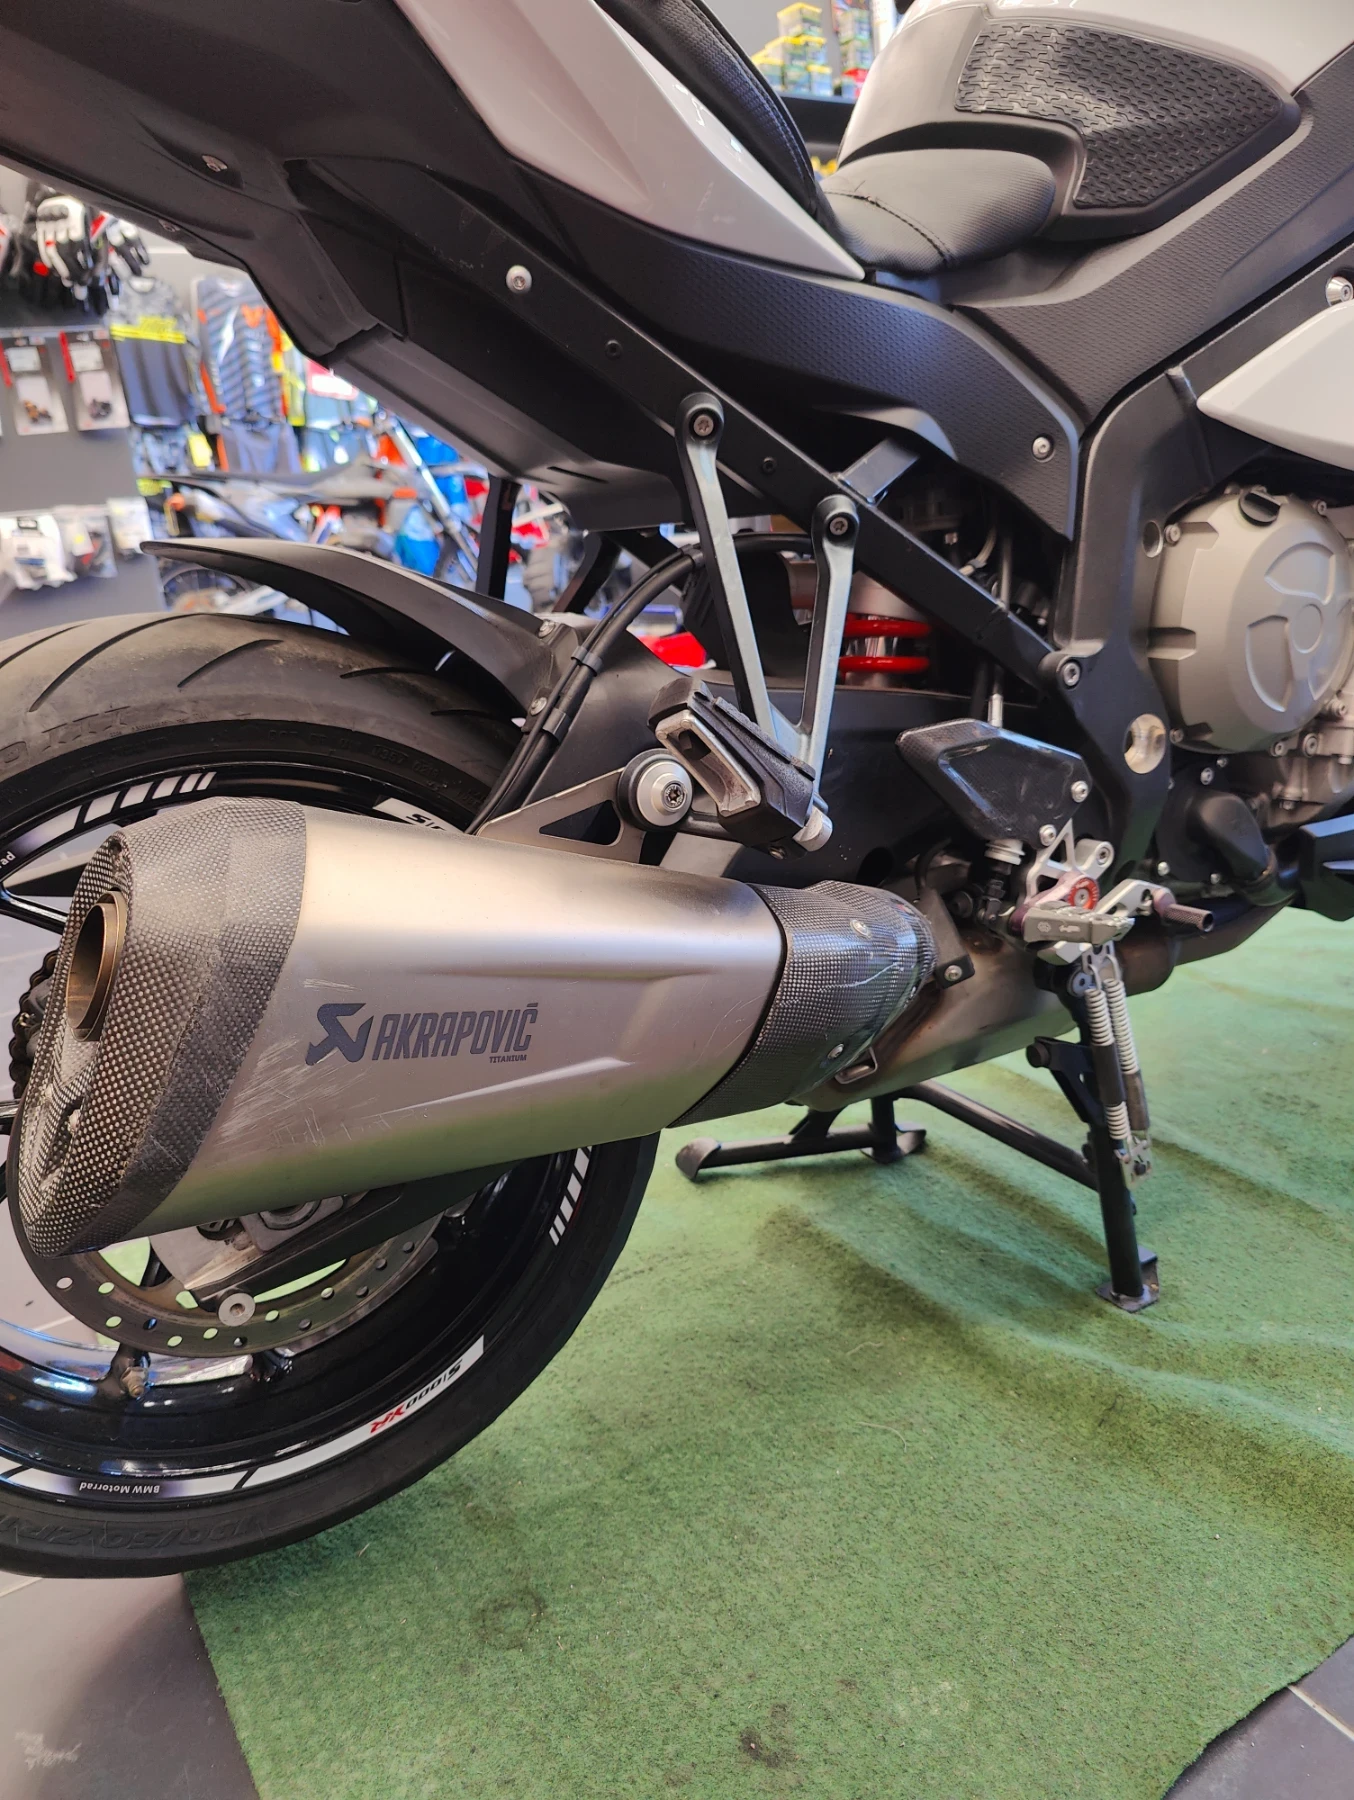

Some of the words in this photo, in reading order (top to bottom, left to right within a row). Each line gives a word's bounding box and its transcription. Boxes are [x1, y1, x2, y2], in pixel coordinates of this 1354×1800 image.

[488, 1054, 528, 1064] TITANIUM
[79, 1481, 130, 1494] Motorrad
[132, 1484, 160, 1494] BMW
